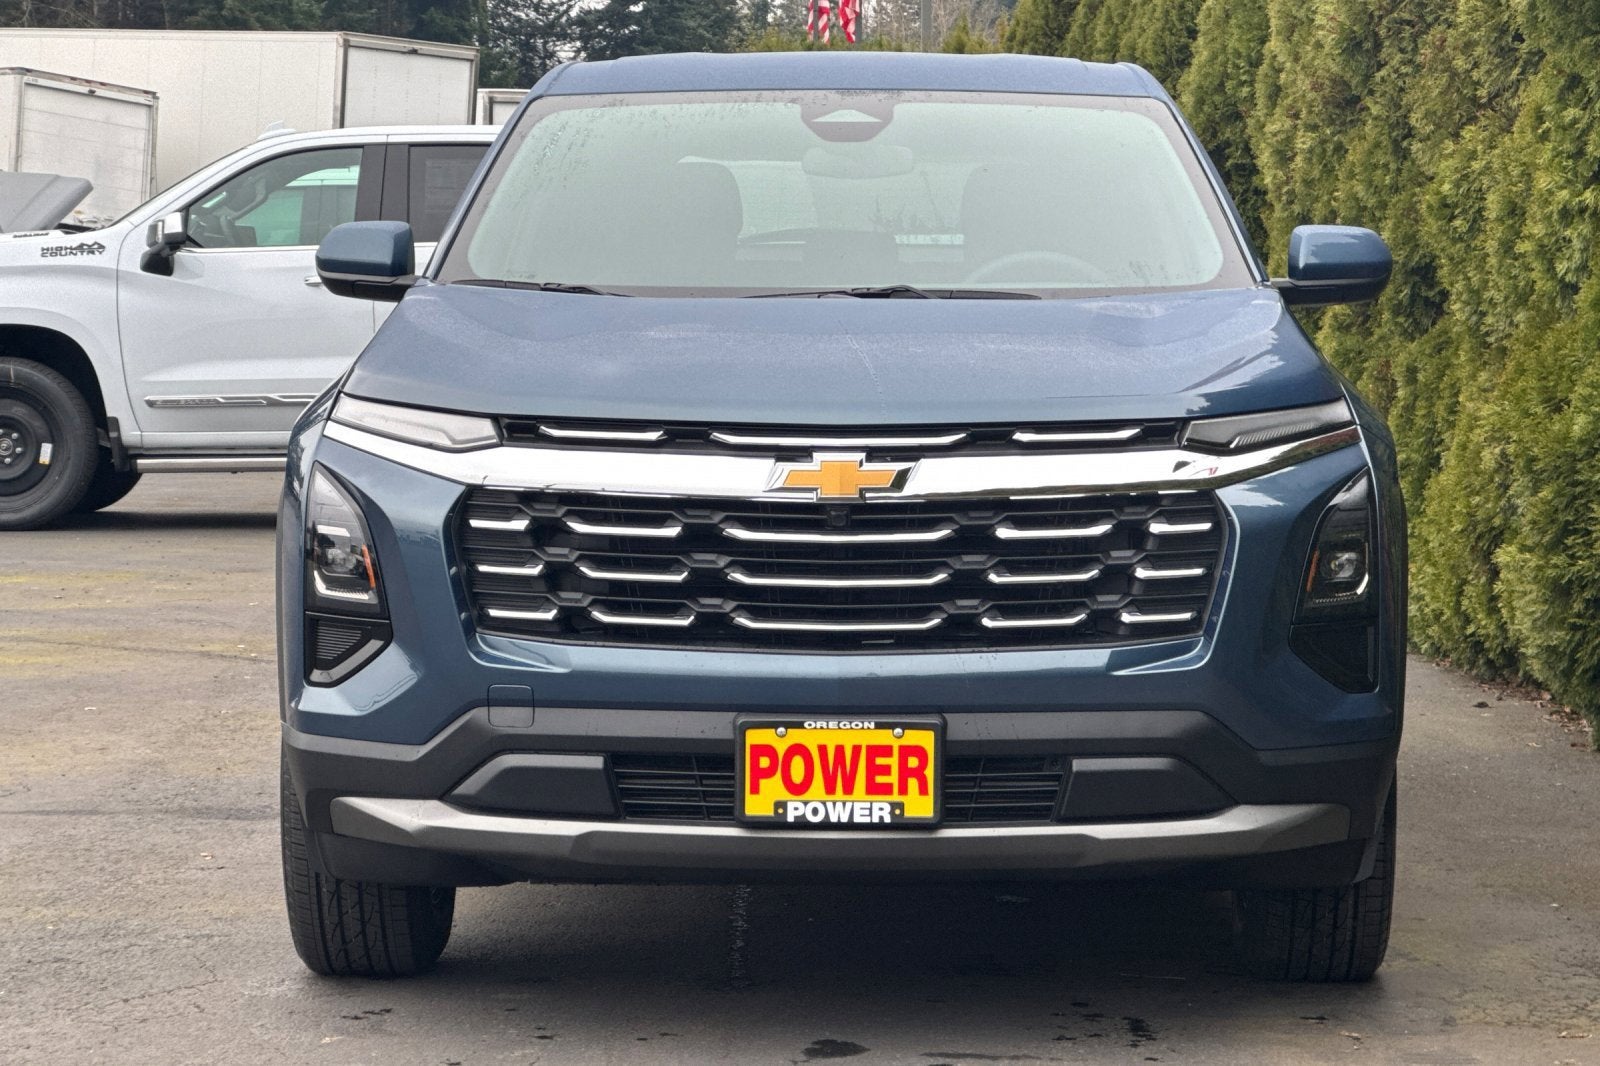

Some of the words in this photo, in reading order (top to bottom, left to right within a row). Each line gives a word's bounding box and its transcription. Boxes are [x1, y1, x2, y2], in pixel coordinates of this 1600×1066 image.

[803, 721, 876, 730] OREGON
[749, 743, 930, 796] POWER
[786, 801, 892, 823] POWER
